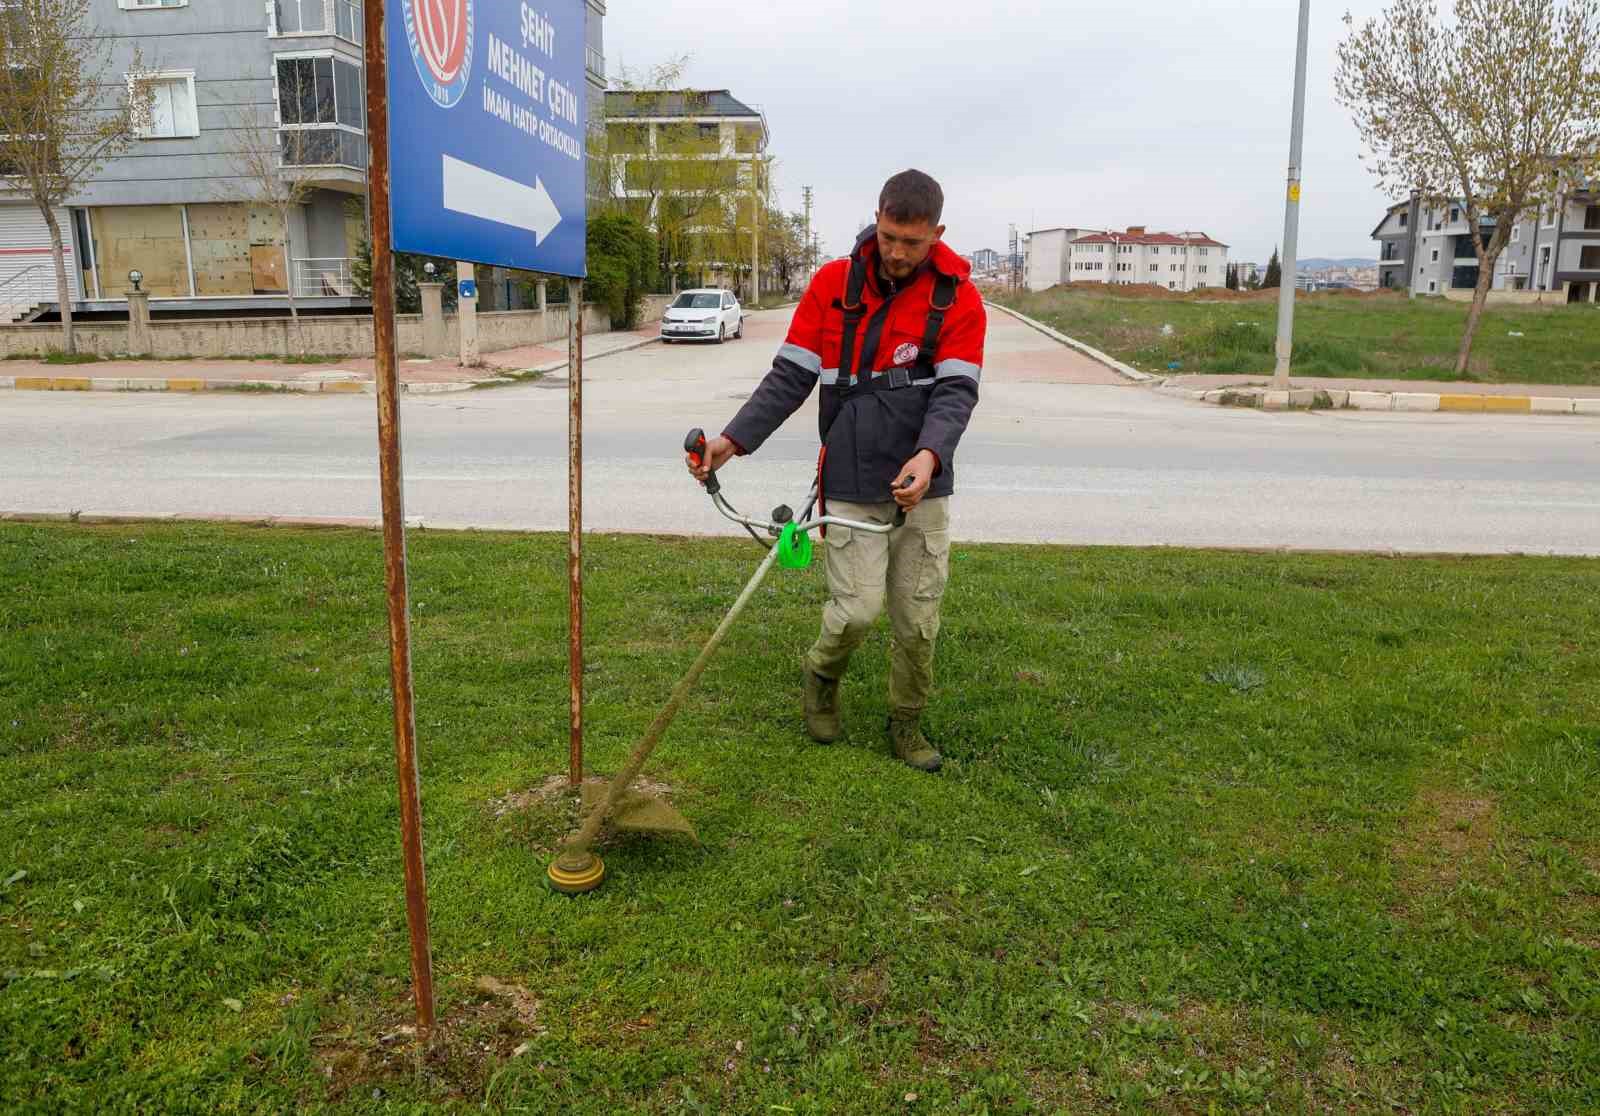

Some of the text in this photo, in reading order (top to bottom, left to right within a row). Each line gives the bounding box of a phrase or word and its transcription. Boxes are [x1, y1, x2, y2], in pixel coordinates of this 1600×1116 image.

[521, 1, 554, 59] ŞEHİT
[483, 78, 581, 161] İMAM HATİP ORTAOKULU
[488, 32, 545, 104] MEHMET
[548, 76, 577, 125] ÇETİN
